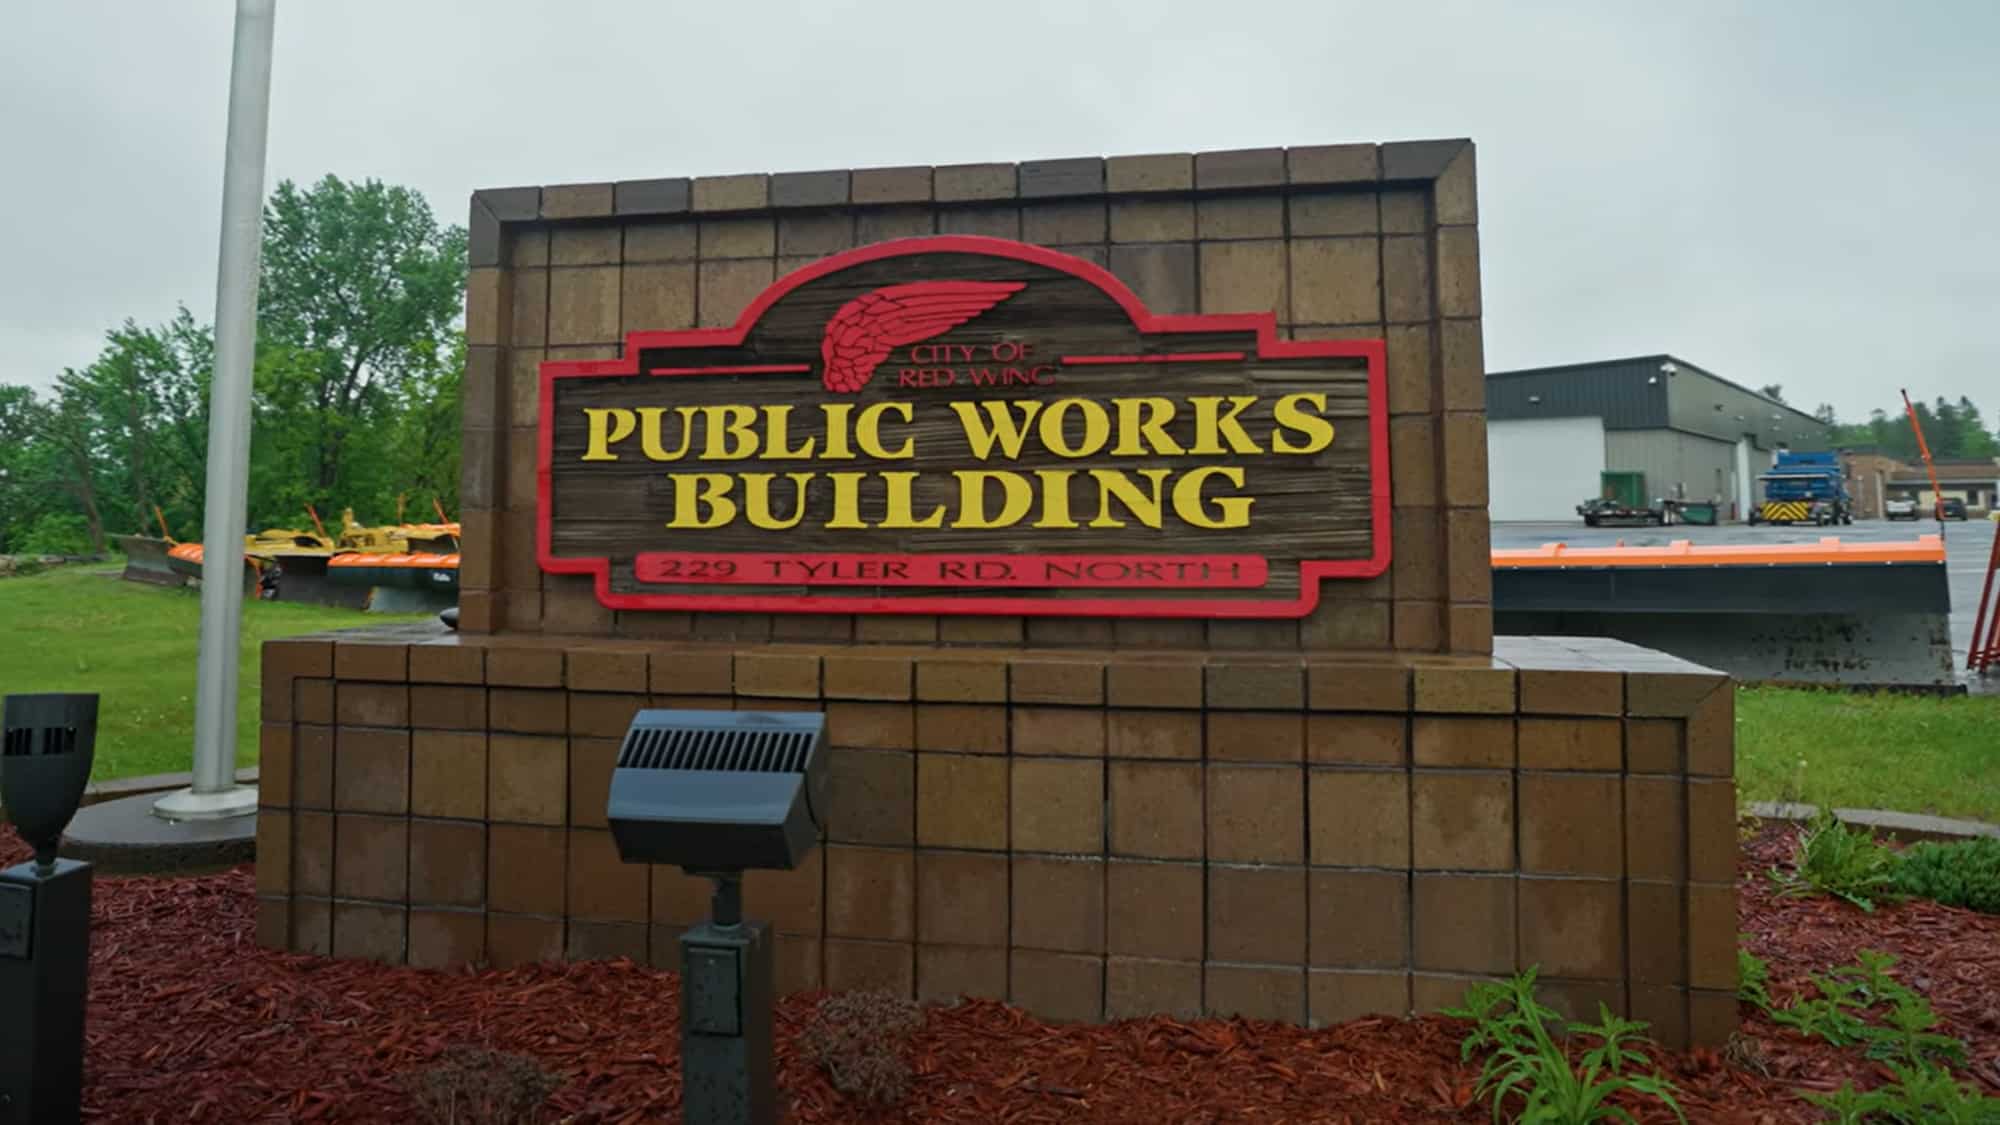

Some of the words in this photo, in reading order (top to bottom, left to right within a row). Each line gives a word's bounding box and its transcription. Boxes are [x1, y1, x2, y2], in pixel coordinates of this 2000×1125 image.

[910, 343, 977, 364] CITY
[991, 342, 1034, 362] OF
[899, 367, 957, 388] RED
[967, 365, 1057, 386] WING
[582, 402, 915, 461] PUBLIC
[949, 392, 1335, 461] WORKS
[665, 466, 1256, 530] BUILDING
[659, 559, 738, 577] 229
[763, 559, 910, 578] TYLER
[938, 560, 1017, 580] RD.
[1044, 560, 1241, 582] NORTH
